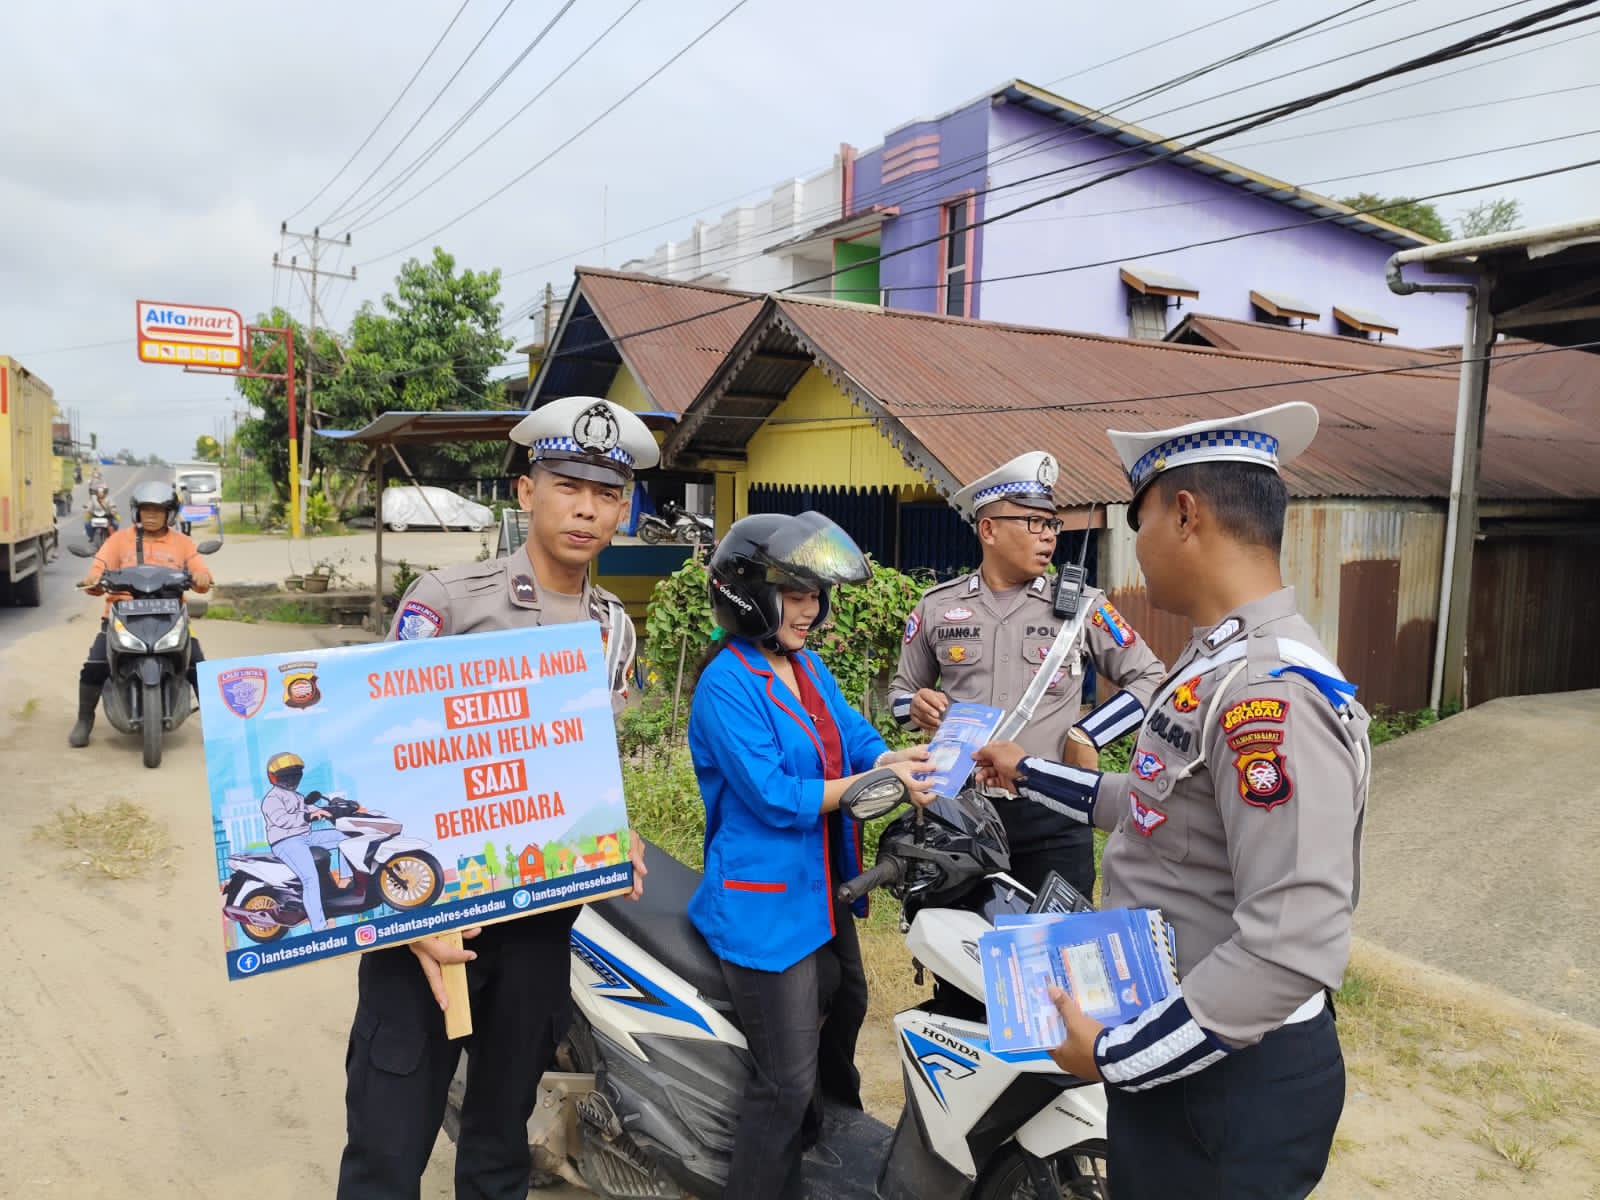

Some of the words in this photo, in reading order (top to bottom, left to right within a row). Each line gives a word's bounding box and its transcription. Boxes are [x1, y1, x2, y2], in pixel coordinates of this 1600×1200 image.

[146, 309, 232, 329] Alfamart
[367, 664, 454, 700] SAYANGI
[459, 655, 533, 687] KEPALA
[539, 648, 588, 680] ANDA
[452, 691, 522, 725] SELALU
[1225, 708, 1282, 728] SEKADAU
[1226, 700, 1279, 721] POLRES
[393, 731, 492, 771] GUNAKAN
[497, 724, 547, 754] HELM
[552, 717, 584, 745] SNI
[471, 762, 520, 796] SAAT
[434, 792, 565, 840] BERKENDARA
[532, 870, 628, 902] lantaspolressekadau
[377, 898, 506, 938] satlantaspolres-sekadau
[261, 937, 348, 965] lantassekadau
[922, 1027, 980, 1060] HONDA
